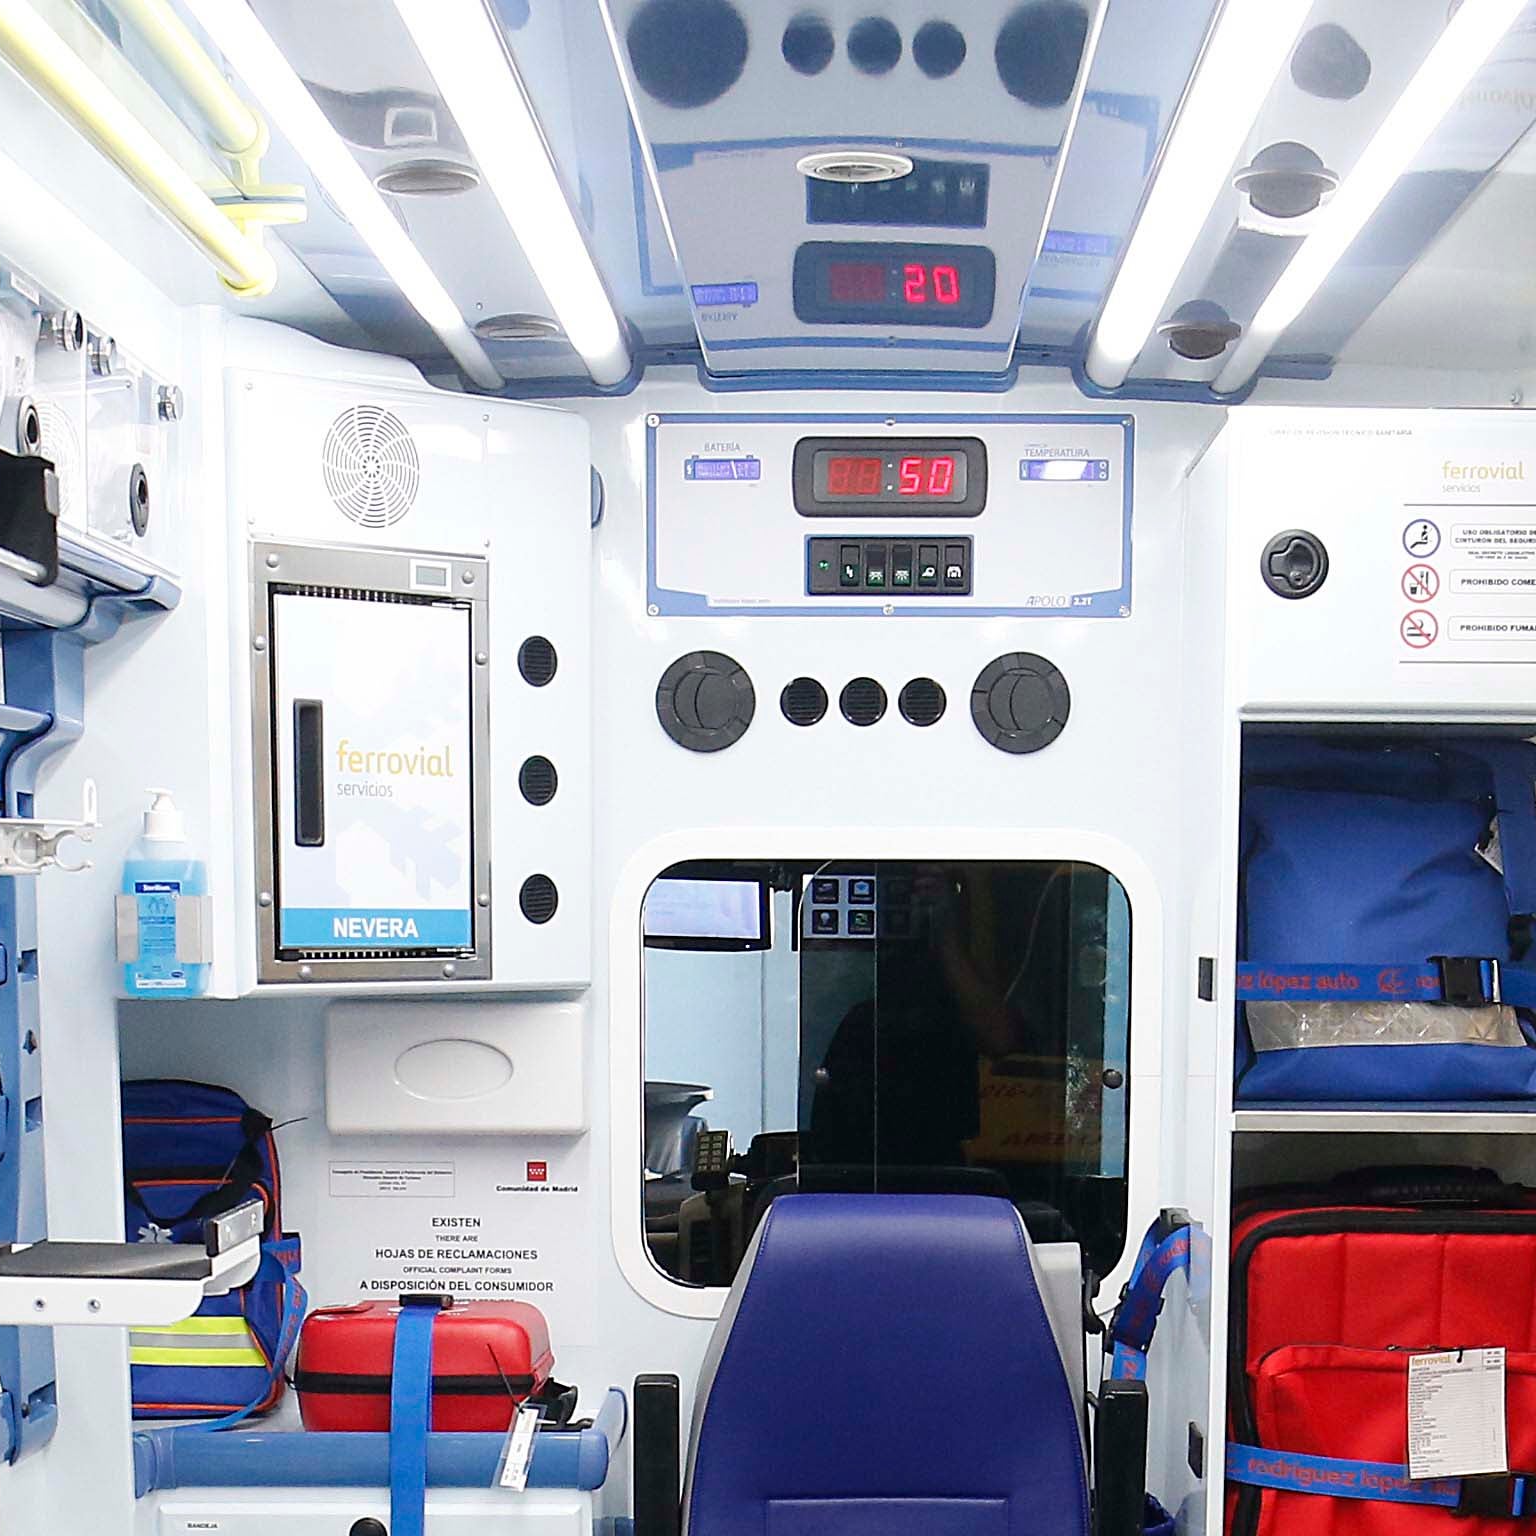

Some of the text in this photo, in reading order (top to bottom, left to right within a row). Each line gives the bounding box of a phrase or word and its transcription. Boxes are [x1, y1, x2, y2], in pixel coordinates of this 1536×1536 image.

[704, 442, 741, 452] BATERÍA
[1025, 449, 1090, 457] TEMPERATURA
[1441, 460, 1524, 480] ferrovial
[1441, 482, 1481, 493] servicios
[1460, 578, 1509, 586] PROHIBIDO
[1460, 624, 1508, 632] PROHIBIDO
[336, 739, 454, 777] ferrovial
[336, 781, 393, 798] servicios
[332, 917, 419, 938] NEVERA
[431, 1217, 481, 1228] EXISTEN
[375, 1249, 538, 1260] HOJAS DE RECLAMACIONES
[403, 1266, 437, 1274] OFFICIAL
[439, 1266, 483, 1274] COMPLAINT
[359, 1279, 554, 1292] A DISPOSICIÓN DEL CONSUMIDOR
